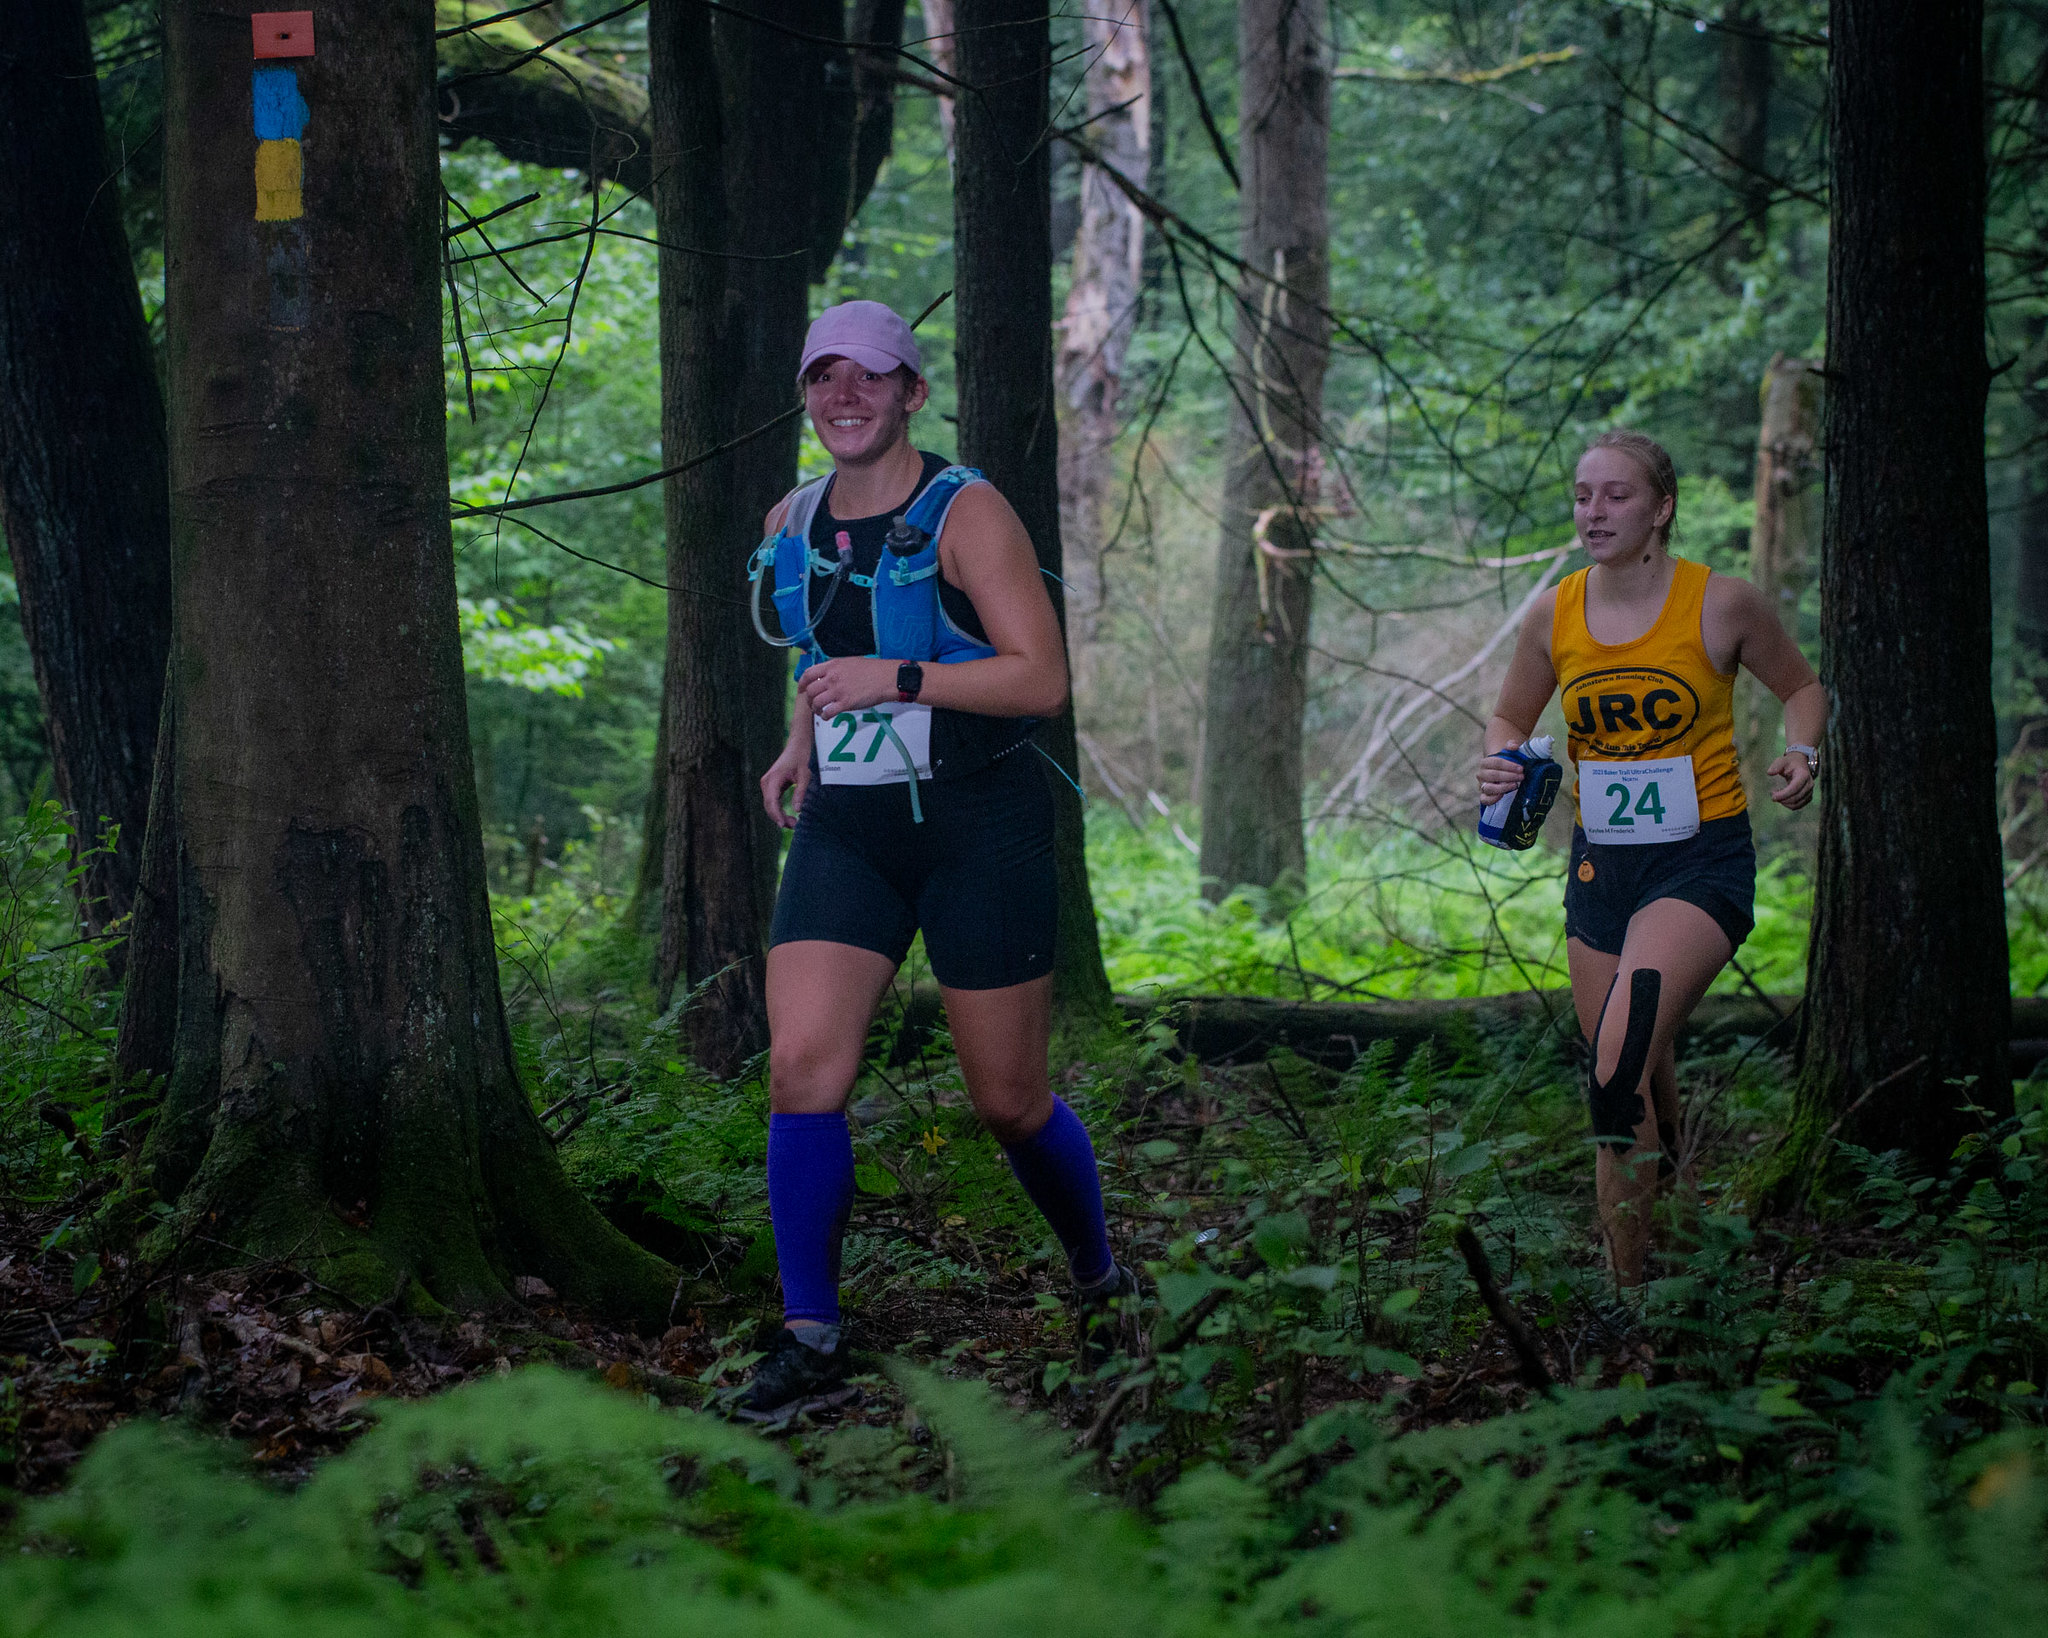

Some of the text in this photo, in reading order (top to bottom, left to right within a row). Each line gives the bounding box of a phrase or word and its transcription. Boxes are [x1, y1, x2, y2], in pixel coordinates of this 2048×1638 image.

[1575, 674, 1664, 692] Johnstown Running Club
[1569, 688, 1683, 735] JRC
[828, 712, 892, 763] 27
[1605, 781, 1666, 826] 24
